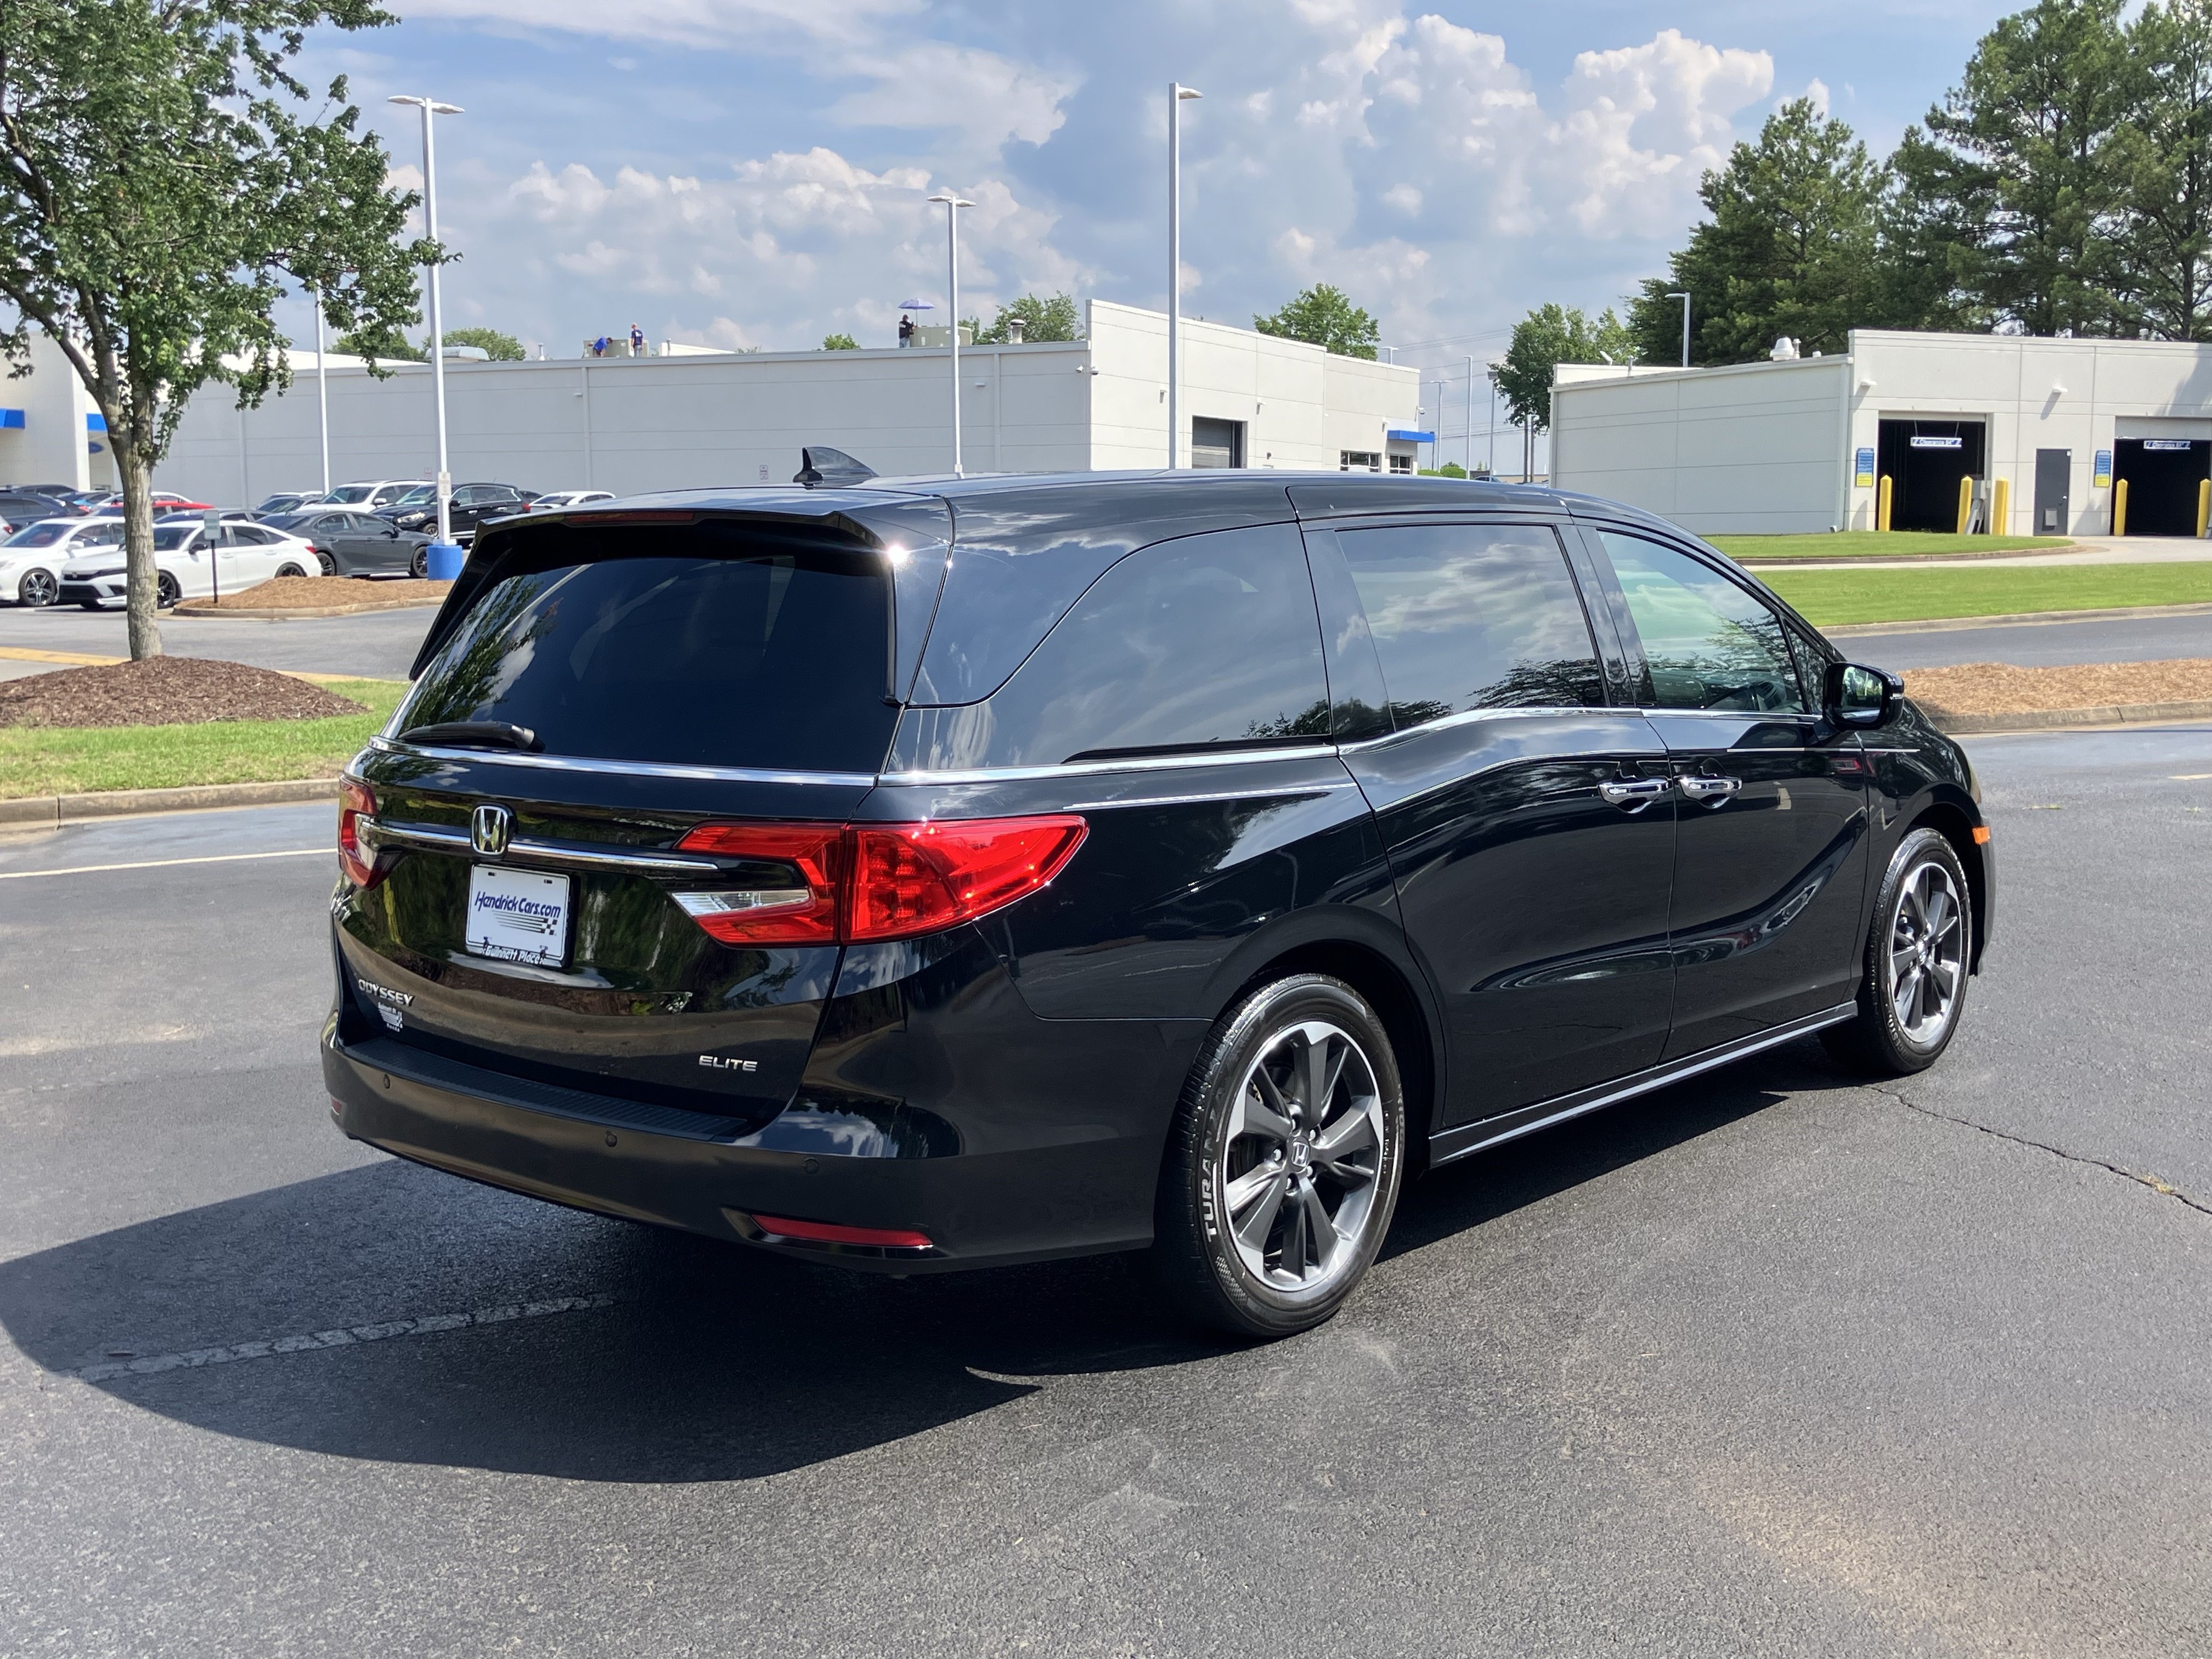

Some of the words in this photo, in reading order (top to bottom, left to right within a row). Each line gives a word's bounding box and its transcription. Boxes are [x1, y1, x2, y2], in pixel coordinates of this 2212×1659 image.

[485, 945, 518, 961] Gwinnett
[517, 950, 540, 964] Place
[358, 979, 414, 1006] ODYSSEY
[699, 1055, 758, 1072] ELITE
